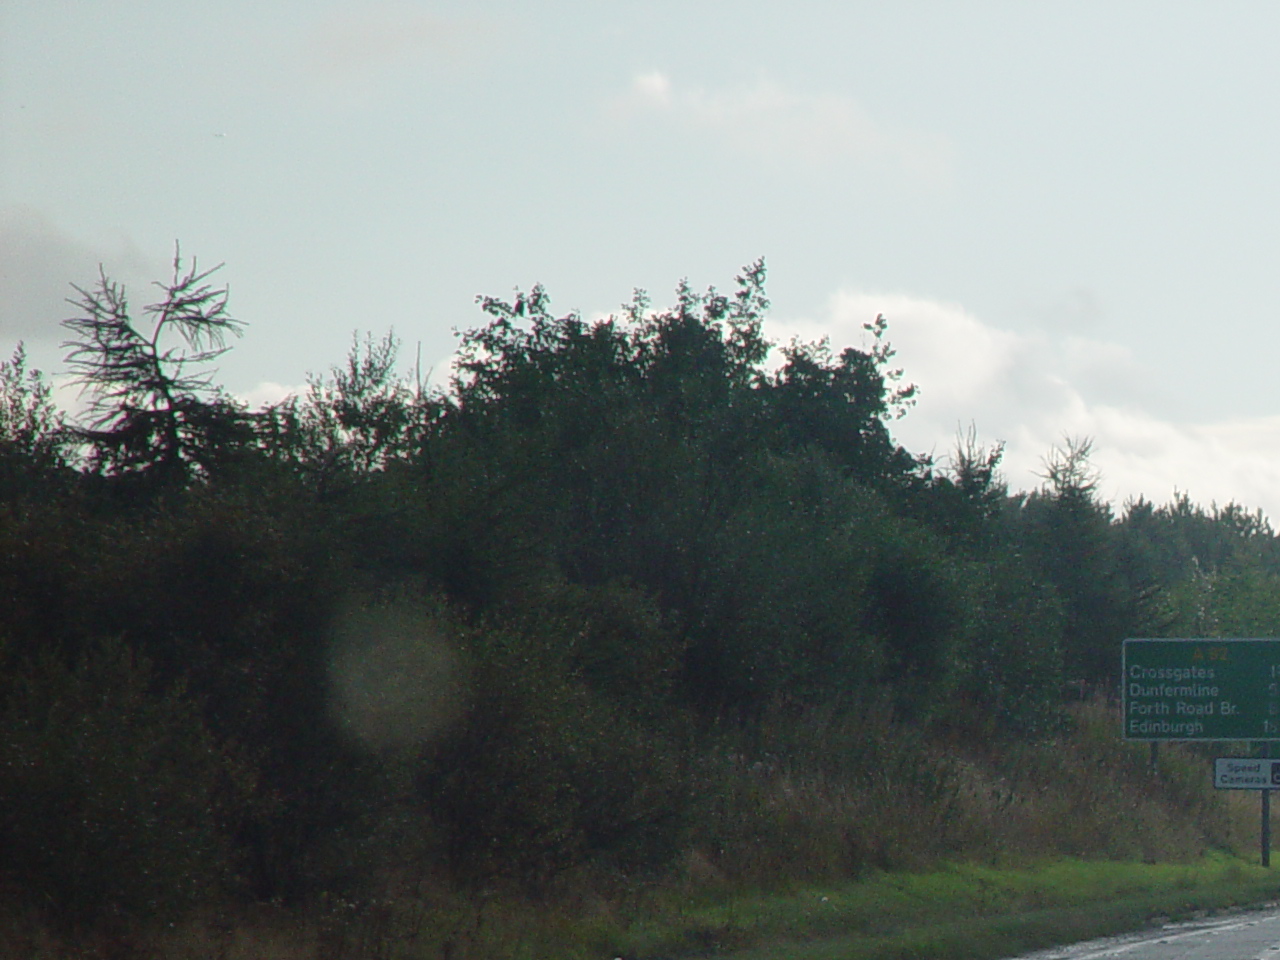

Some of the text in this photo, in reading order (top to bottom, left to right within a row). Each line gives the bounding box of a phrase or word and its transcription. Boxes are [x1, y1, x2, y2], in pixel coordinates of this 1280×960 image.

[1129, 665, 1215, 682] Crossgates
[1129, 682, 1219, 697] Dunfermline
[1129, 701, 1240, 715] Forth Road Br.
[1129, 719, 1204, 736] Edinburgh
[1227, 763, 1261, 774] Speed
[1220, 774, 1267, 785] Cameras
